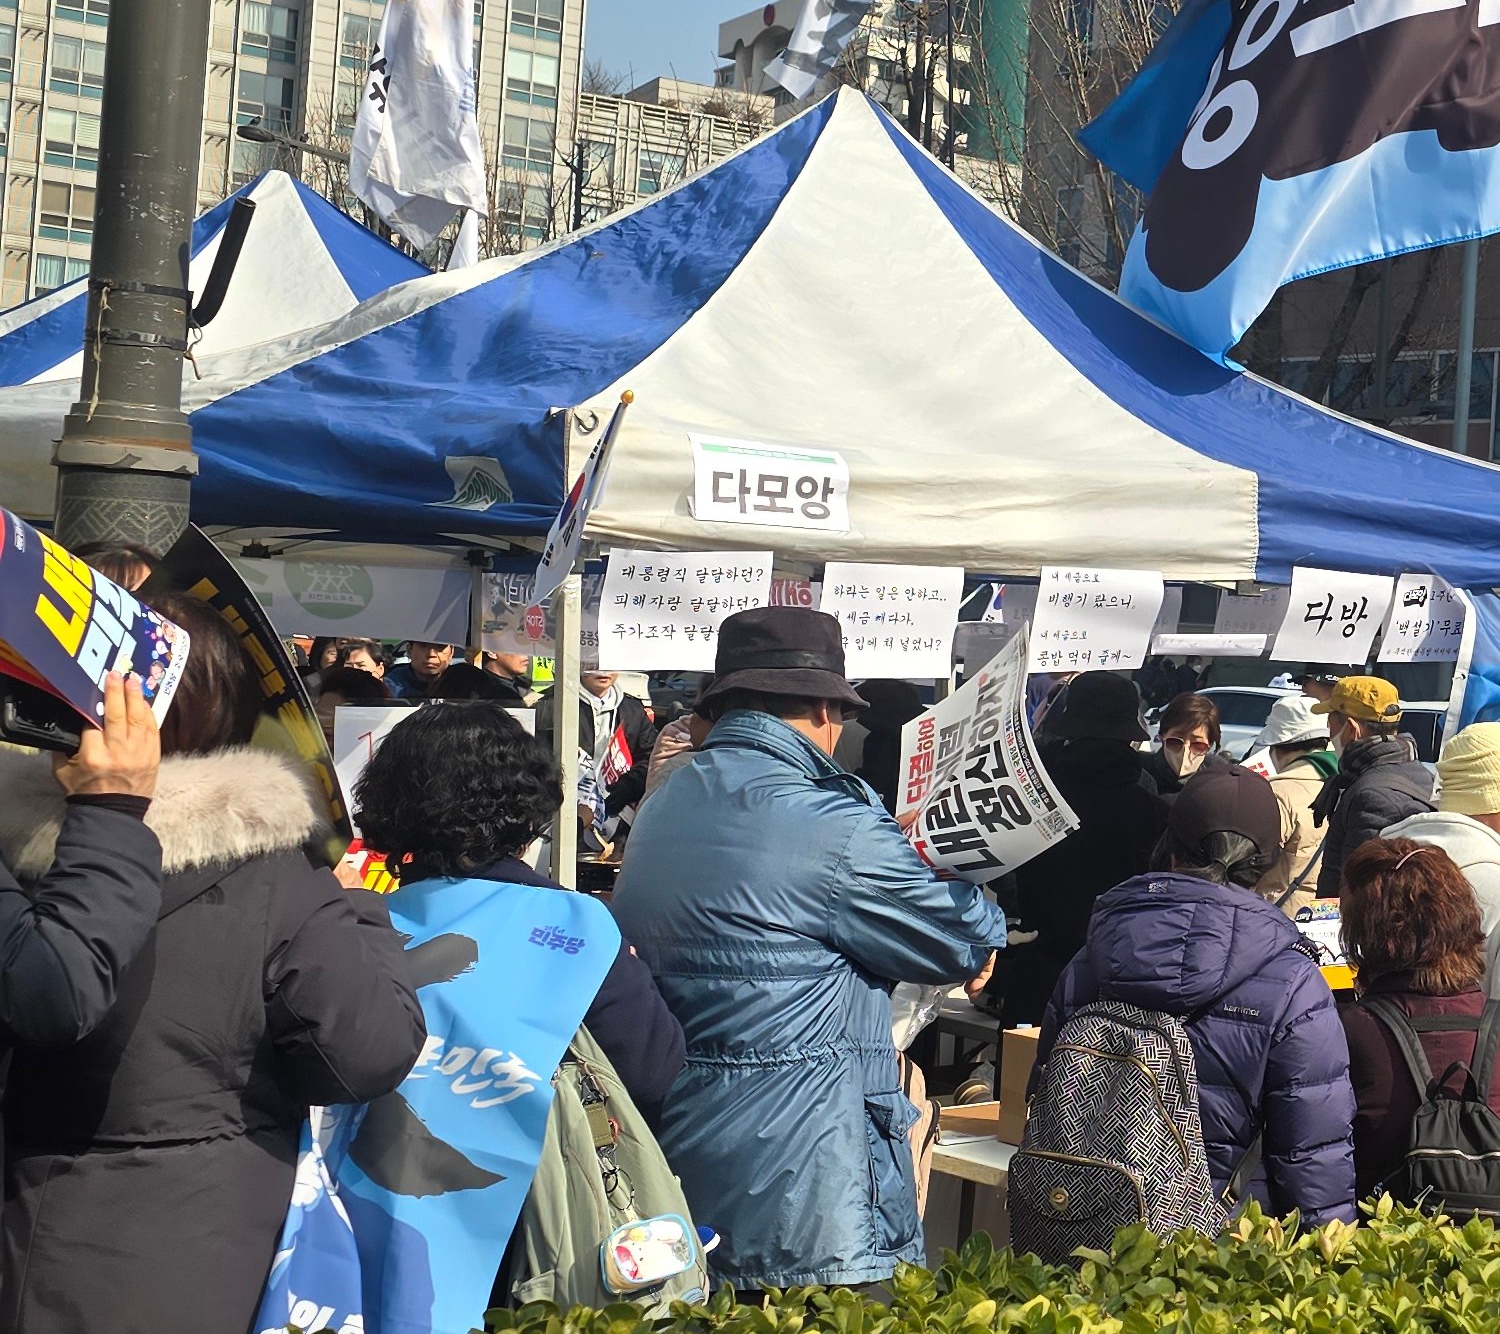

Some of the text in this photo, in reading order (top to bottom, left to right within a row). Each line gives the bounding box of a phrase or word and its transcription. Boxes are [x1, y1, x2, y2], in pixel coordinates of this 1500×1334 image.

[712, 468, 835, 519] 다모앙
[621, 565, 687, 583] 대통령직
[833, 584, 870, 599] 하라는
[875, 586, 899, 601] 일은
[1048, 592, 1088, 608] 비행기
[613, 593, 682, 611] 피해자랑
[846, 611, 871, 626] 세금
[1303, 592, 1369, 639] 다방
[612, 623, 677, 641] 주가조작
[855, 637, 877, 650] 입에
[900, 637, 942, 652] 넣었니?
[1037, 650, 1063, 667] 콩밥
[906, 716, 936, 805] 단결하여
[964, 671, 1033, 834] 청산하자
[528, 927, 586, 955] 민주당
